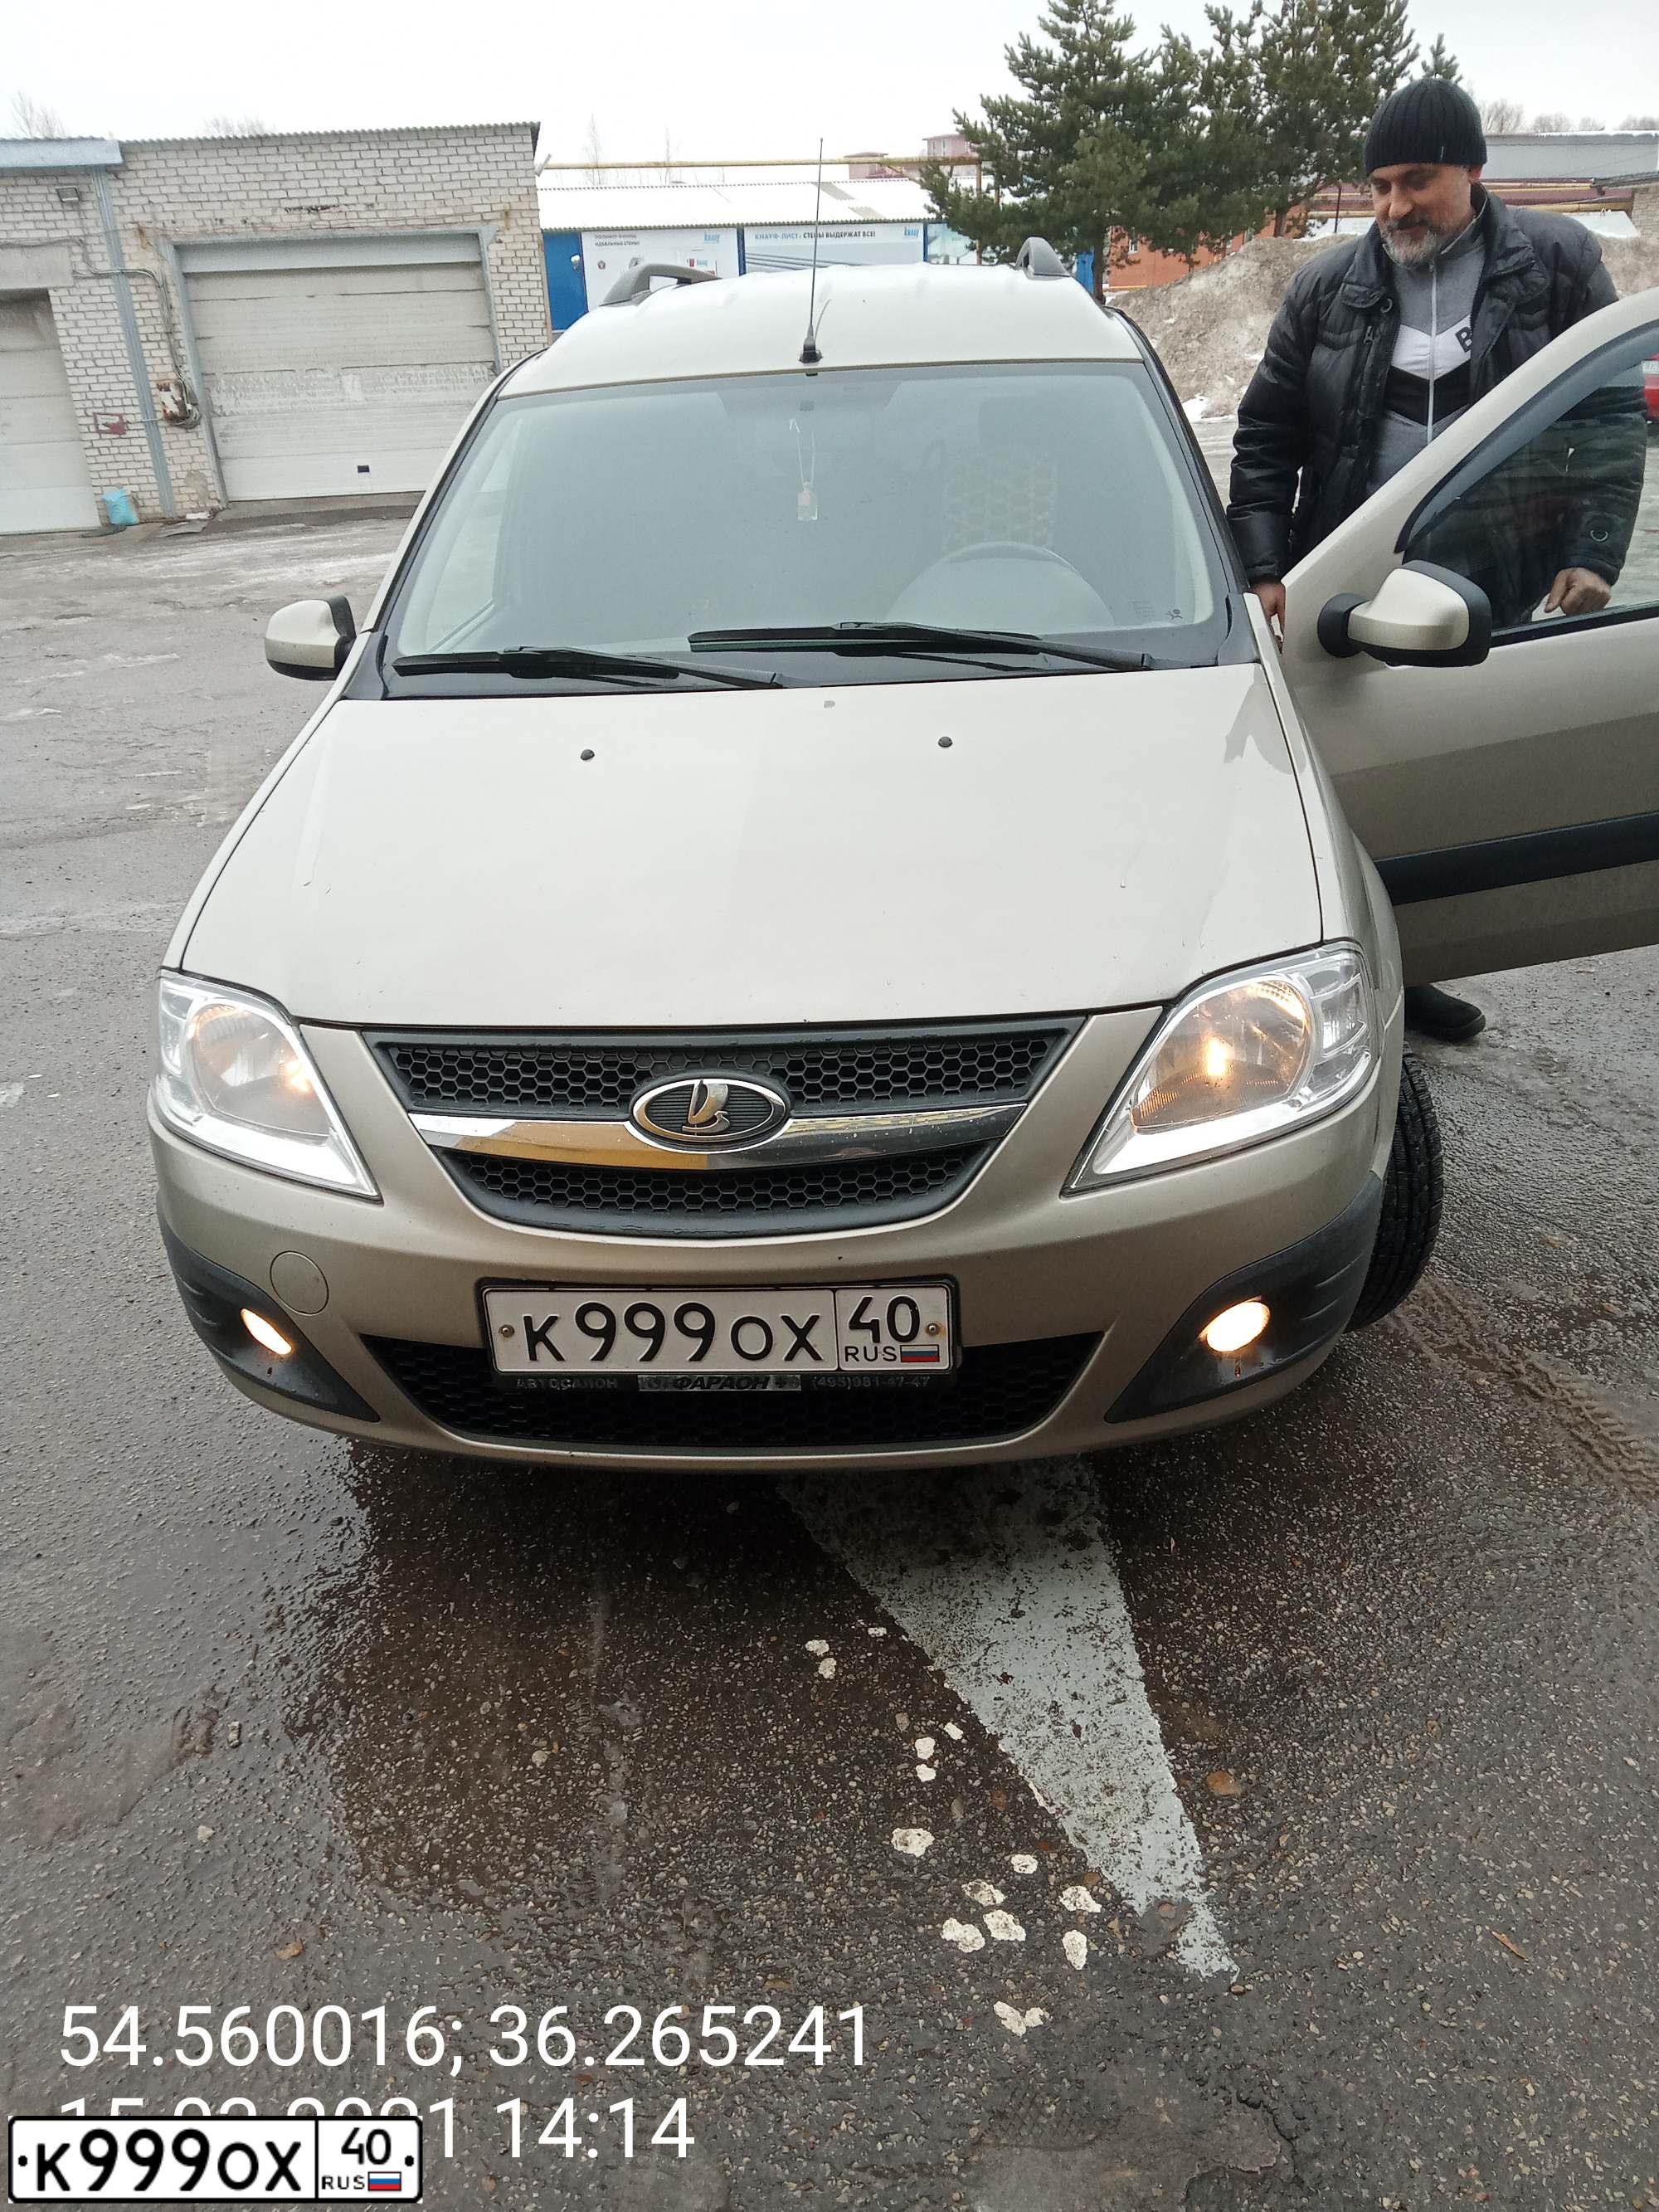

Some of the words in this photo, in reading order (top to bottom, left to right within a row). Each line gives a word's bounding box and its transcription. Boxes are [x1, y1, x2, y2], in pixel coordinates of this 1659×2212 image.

[825, 231, 861, 240] ВЫДЕРЖАТ
[848, 1295, 921, 1344] 40
[844, 1345, 898, 1362] RUS
[675, 1376, 771, 1390] ФАРАОН
